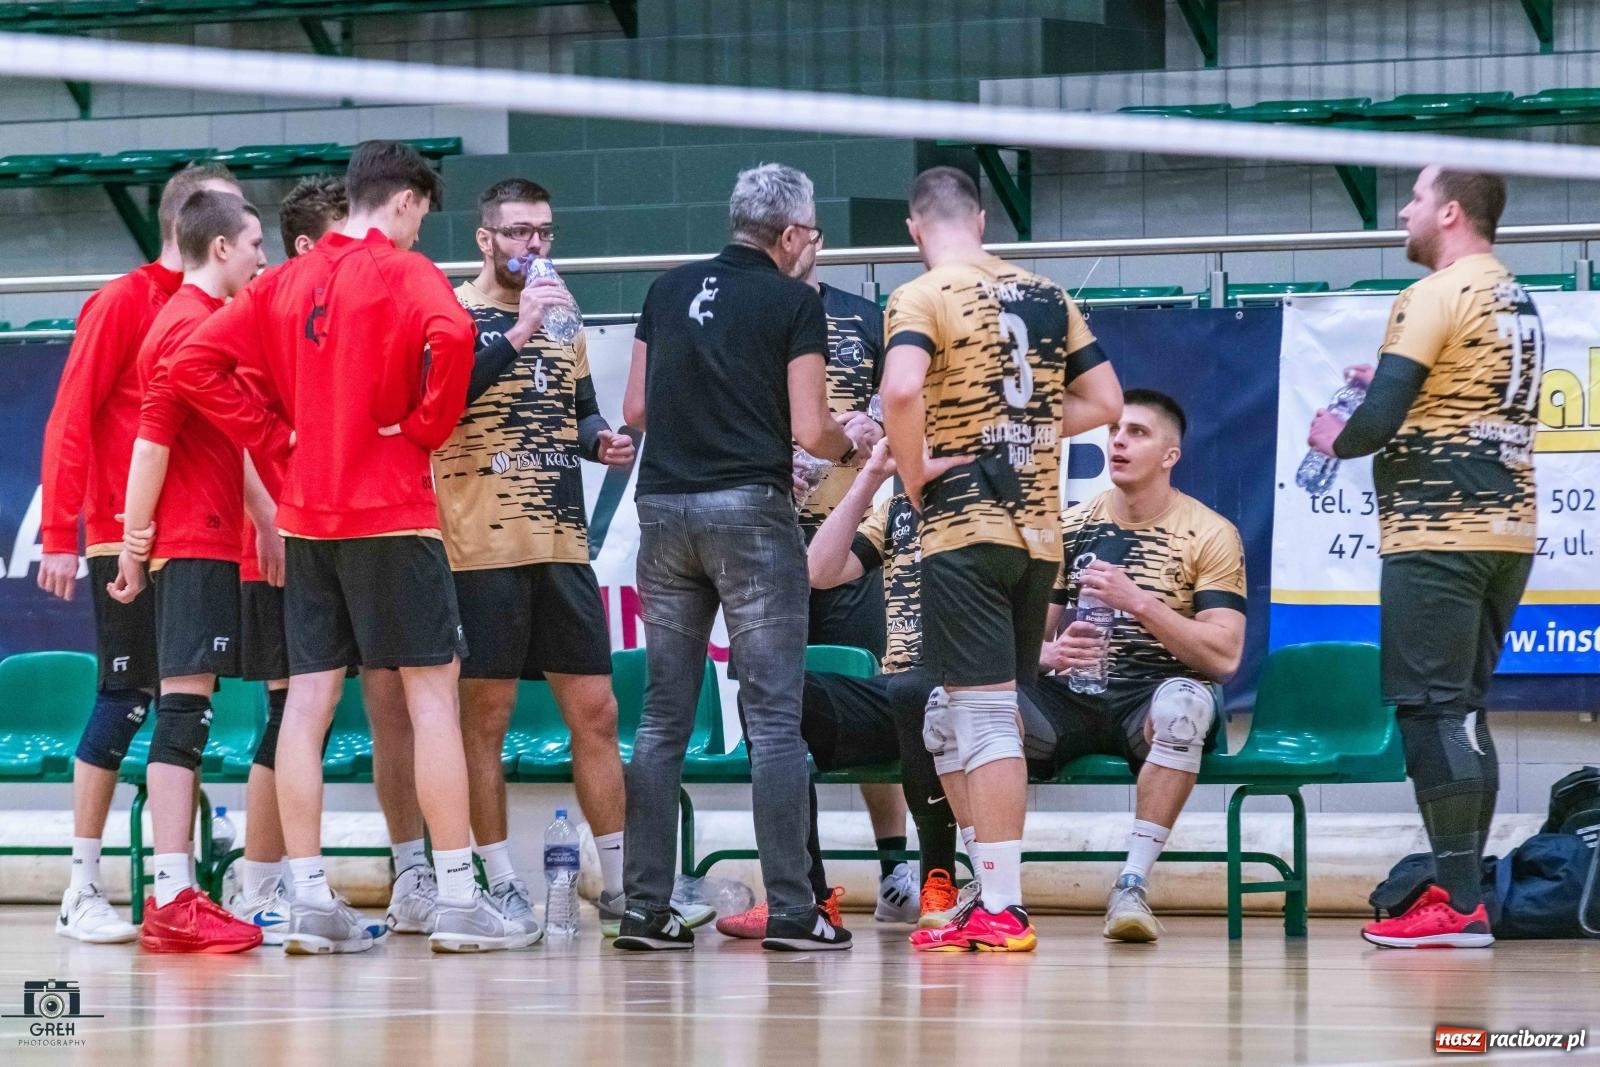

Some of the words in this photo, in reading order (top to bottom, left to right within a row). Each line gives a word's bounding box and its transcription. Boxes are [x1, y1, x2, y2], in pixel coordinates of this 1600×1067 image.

[997, 311, 1034, 409] 3
[533, 358, 548, 393] 6
[1311, 491, 1351, 514] tel.
[1551, 489, 1595, 513] 502
[1328, 534, 1378, 559] 47-
[1535, 537, 1556, 559] z,
[1563, 529, 1594, 556] ul.
[1505, 621, 1600, 653] w.inst
